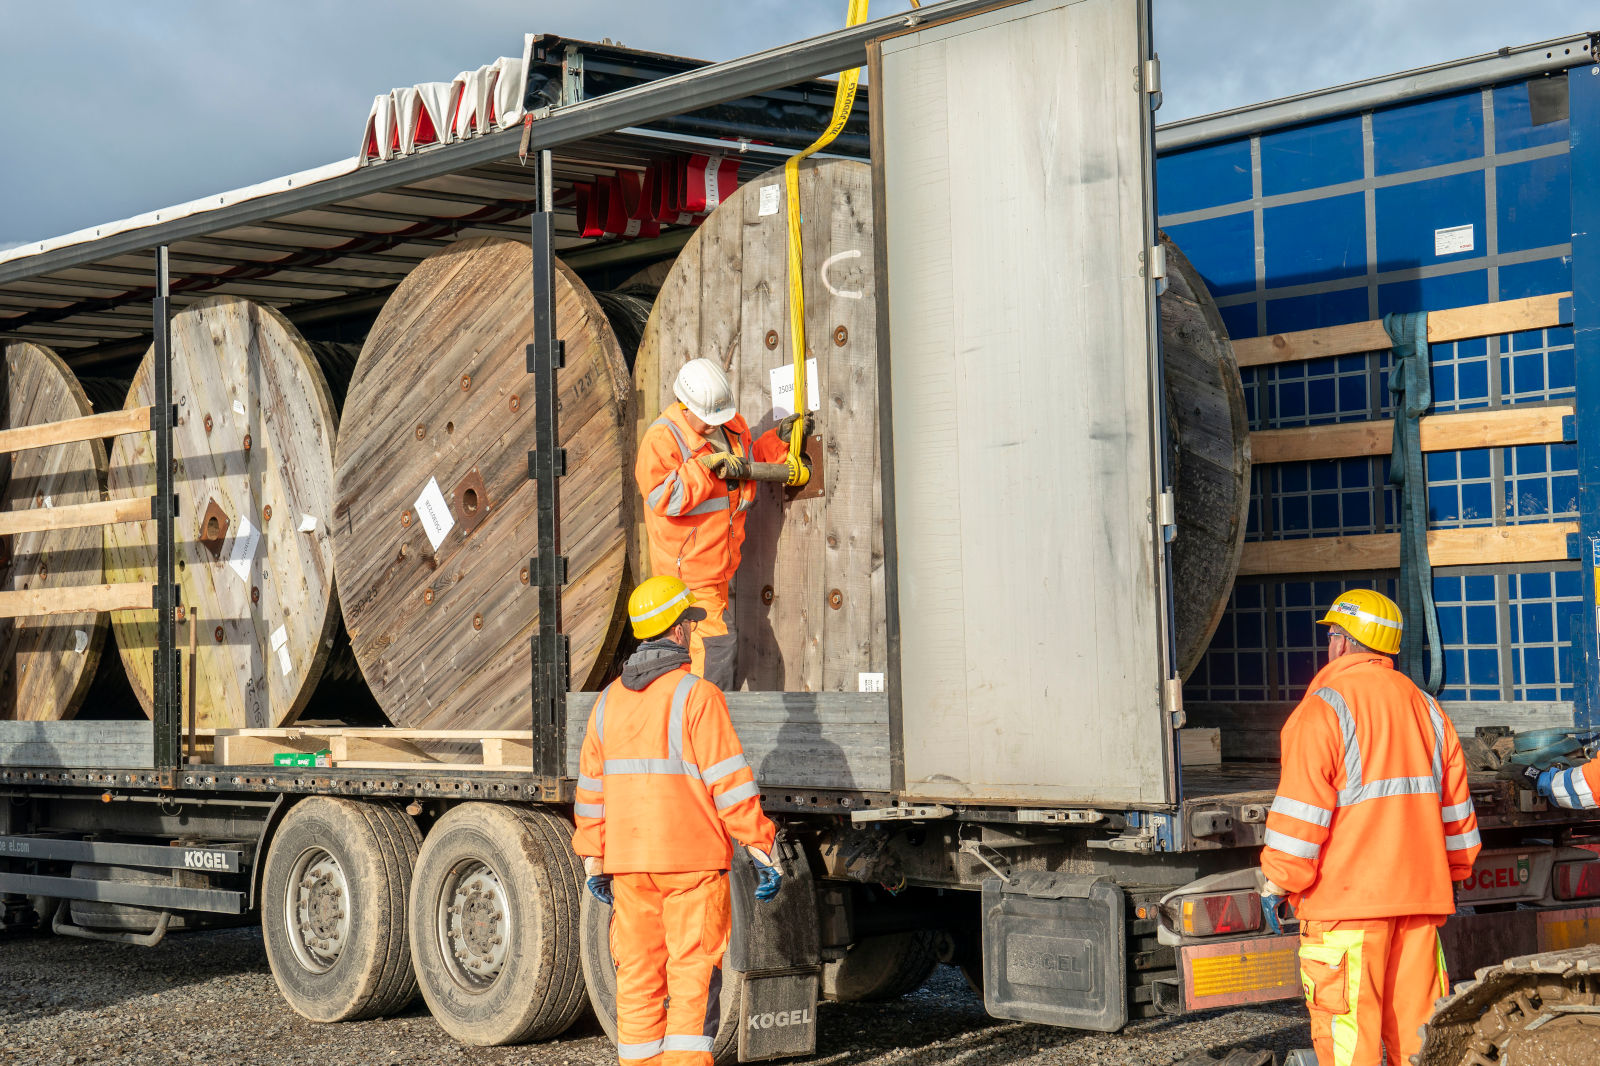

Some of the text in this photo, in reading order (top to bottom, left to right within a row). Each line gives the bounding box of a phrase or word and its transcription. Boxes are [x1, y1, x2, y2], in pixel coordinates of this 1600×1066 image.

[184, 850, 230, 869] KÖGEL
[1463, 866, 1520, 891] ÖGEL
[747, 1008, 813, 1031] KÖGEL
